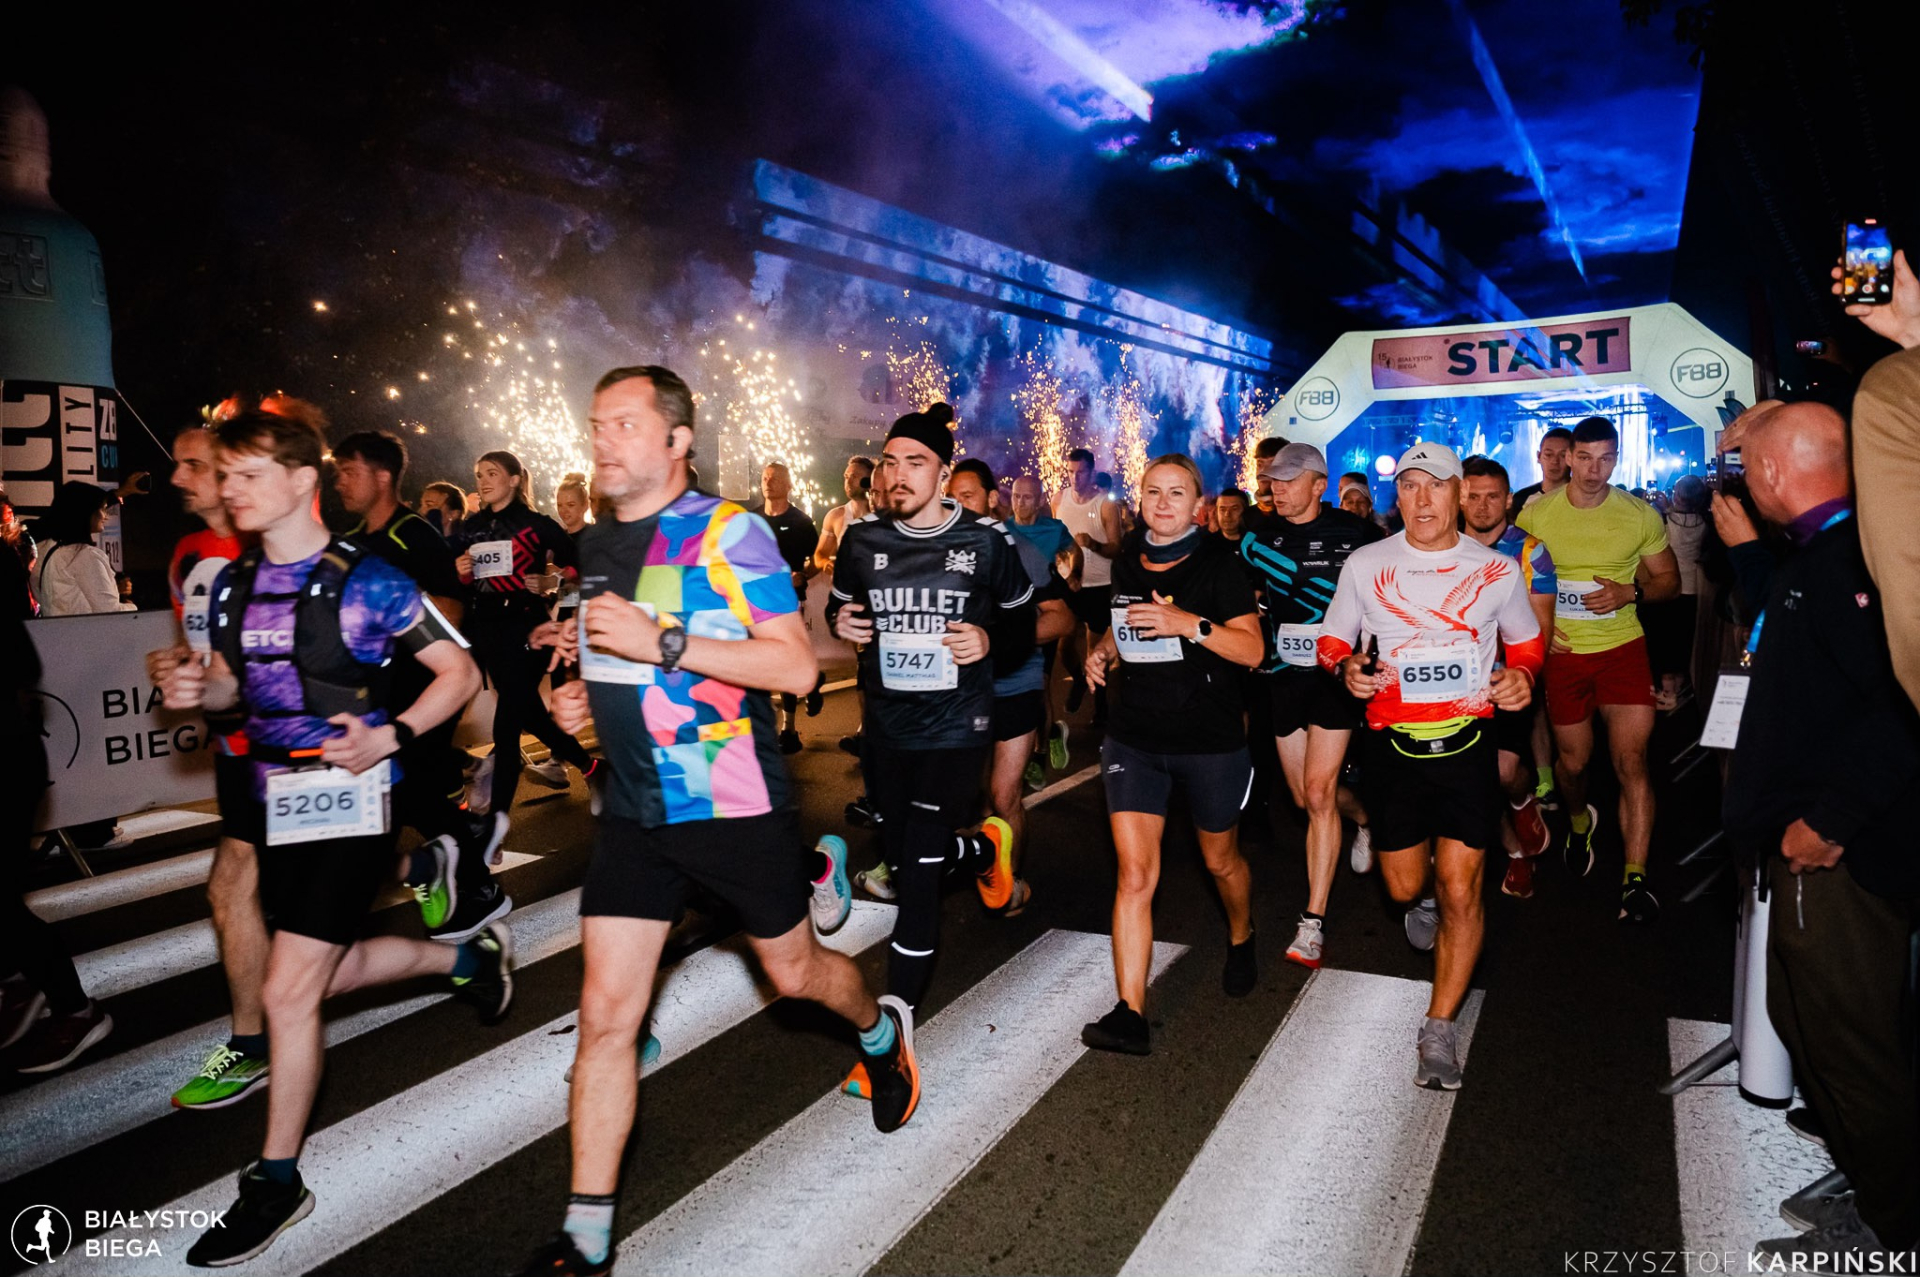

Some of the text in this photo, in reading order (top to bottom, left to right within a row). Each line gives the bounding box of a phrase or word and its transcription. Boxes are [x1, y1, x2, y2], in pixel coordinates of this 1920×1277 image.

[1447, 328, 1620, 376] START
[1676, 362, 1722, 383] F88
[1299, 390, 1334, 406] F88
[472, 552, 501, 566] 405
[874, 553, 889, 570] B
[868, 587, 971, 615] BULLET
[888, 613, 947, 634] CLUB
[241, 629, 295, 648] ETC
[1282, 637, 1317, 651] 530
[886, 652, 935, 669] 5747
[1403, 664, 1463, 683] 6550
[102, 686, 165, 719] BIA
[275, 791, 354, 817] 5206
